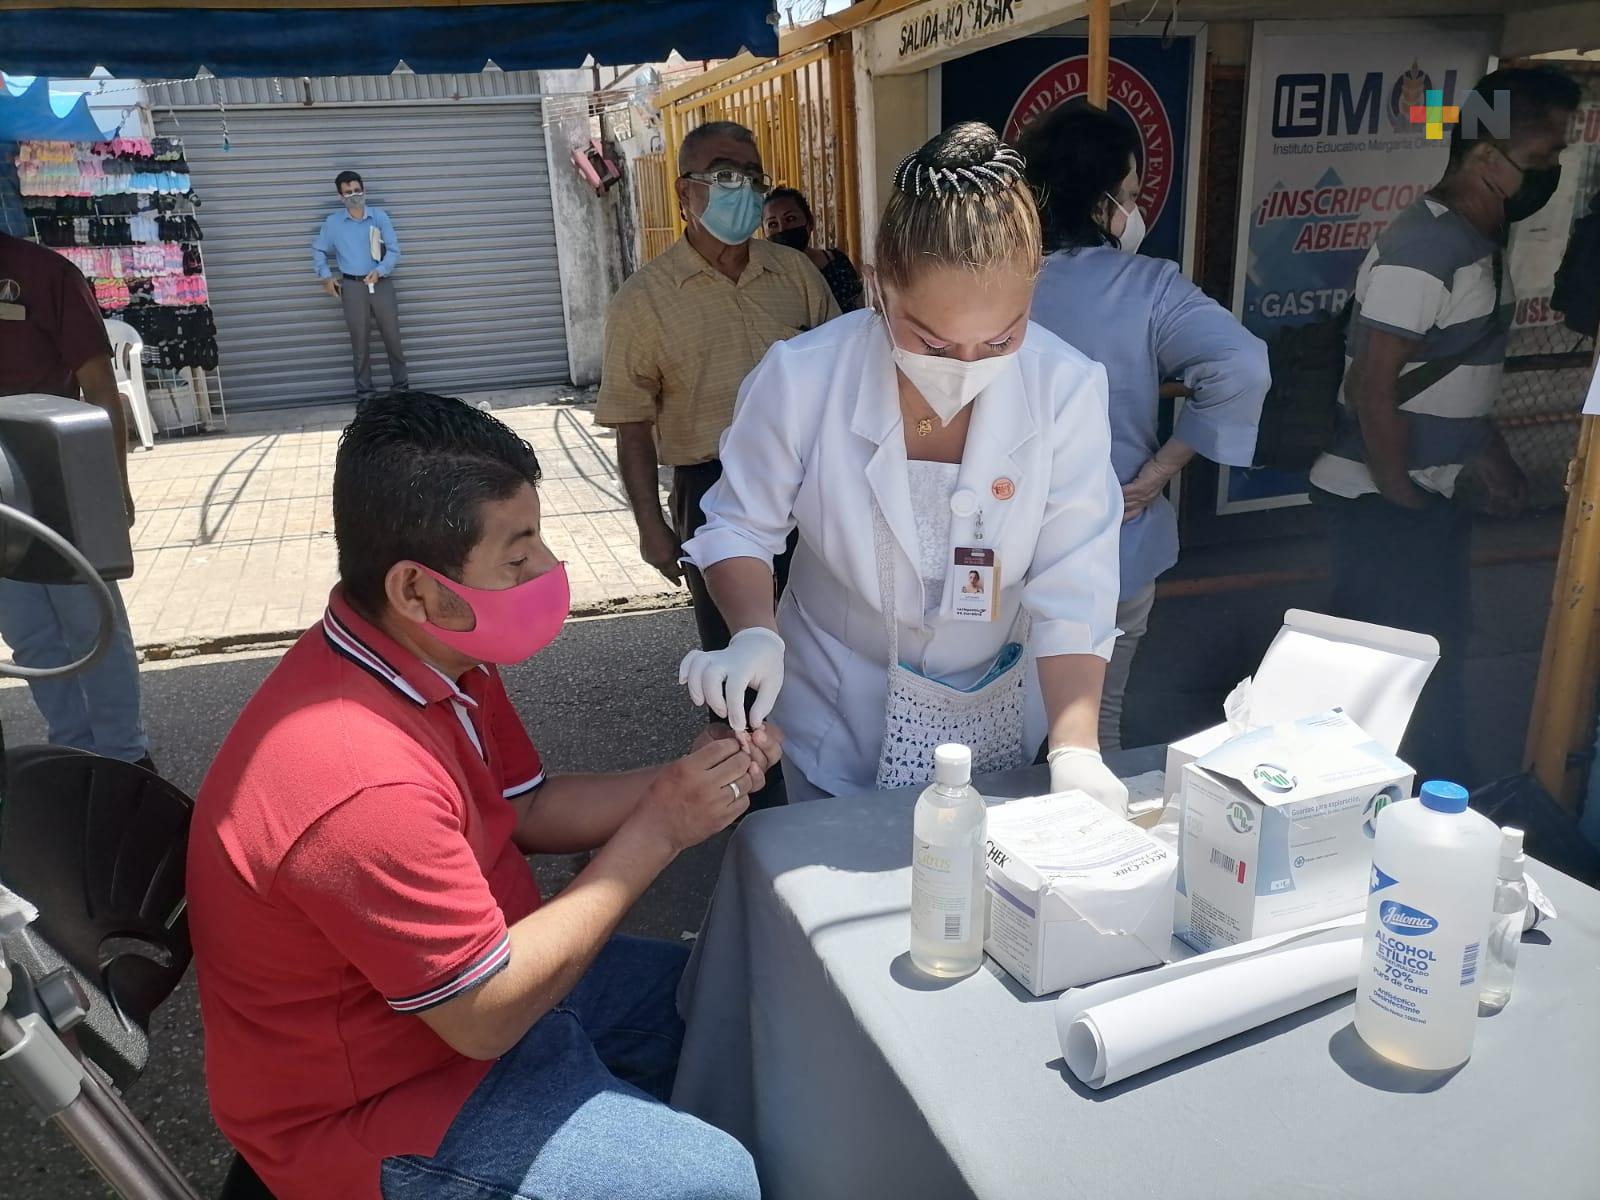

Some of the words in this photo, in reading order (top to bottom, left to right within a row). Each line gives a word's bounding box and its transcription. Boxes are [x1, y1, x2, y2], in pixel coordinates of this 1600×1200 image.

[1273, 142, 1314, 155] Instituto
[1317, 140, 1365, 153] Educativo
[1294, 221, 1388, 251] ABIERT
[1262, 291, 1354, 318] GASTR
[986, 840, 1009, 868] CHEK
[1382, 906, 1433, 929] Jaloma
[1375, 930, 1437, 961] ALCOHOL
[1378, 942, 1429, 971] ETÍLICO
[1373, 967, 1390, 981] Puro
[1391, 978, 1402, 987] de
[1384, 964, 1414, 983] 70%
[1373, 990, 1421, 1015] Desinfectante
